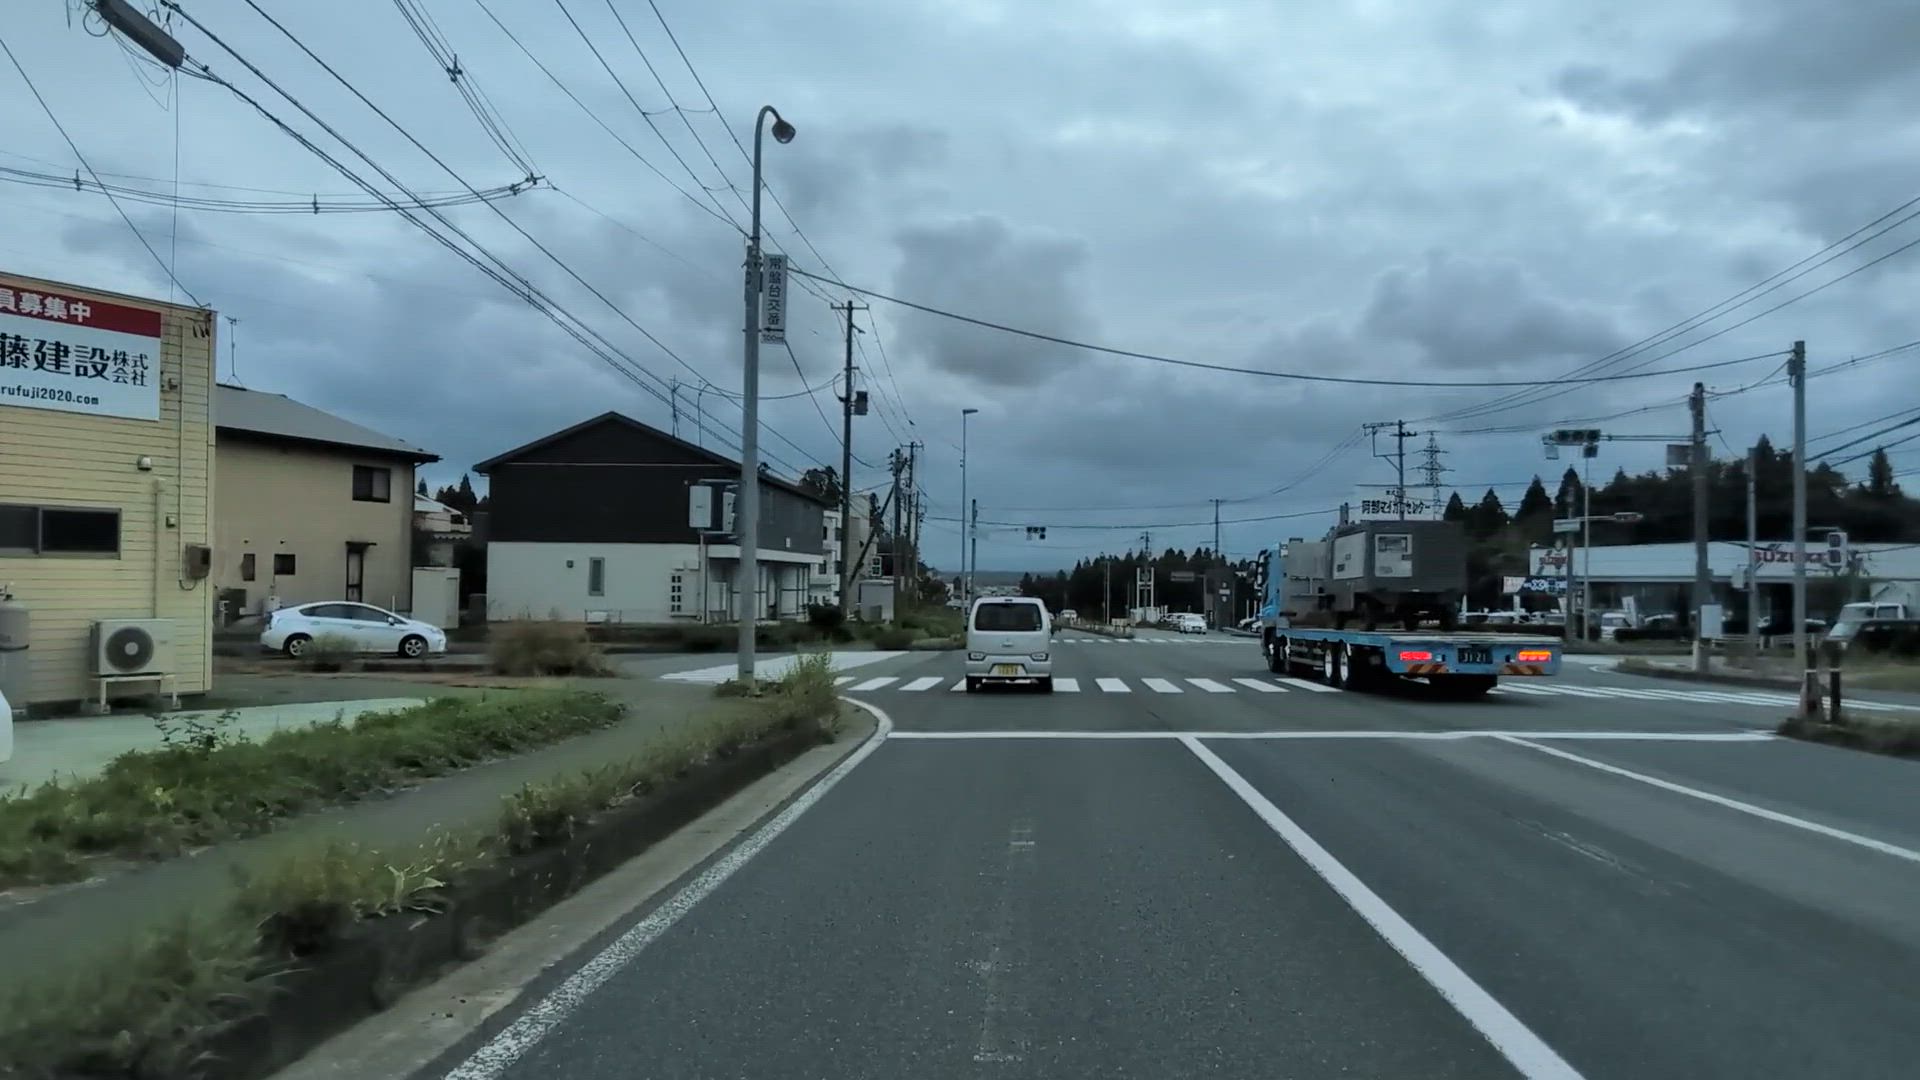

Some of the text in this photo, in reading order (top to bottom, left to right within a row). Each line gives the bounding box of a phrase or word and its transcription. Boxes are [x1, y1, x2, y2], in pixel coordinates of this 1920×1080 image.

[0, 288, 91, 322] 員募集中
[0, 332, 110, 381] 藤建設
[112, 349, 148, 370] 株式
[112, 367, 148, 387] 会社
[1, 385, 99, 405] rufuji2020.com
[1362, 500, 1431, 515] 阿部マイカセンター
